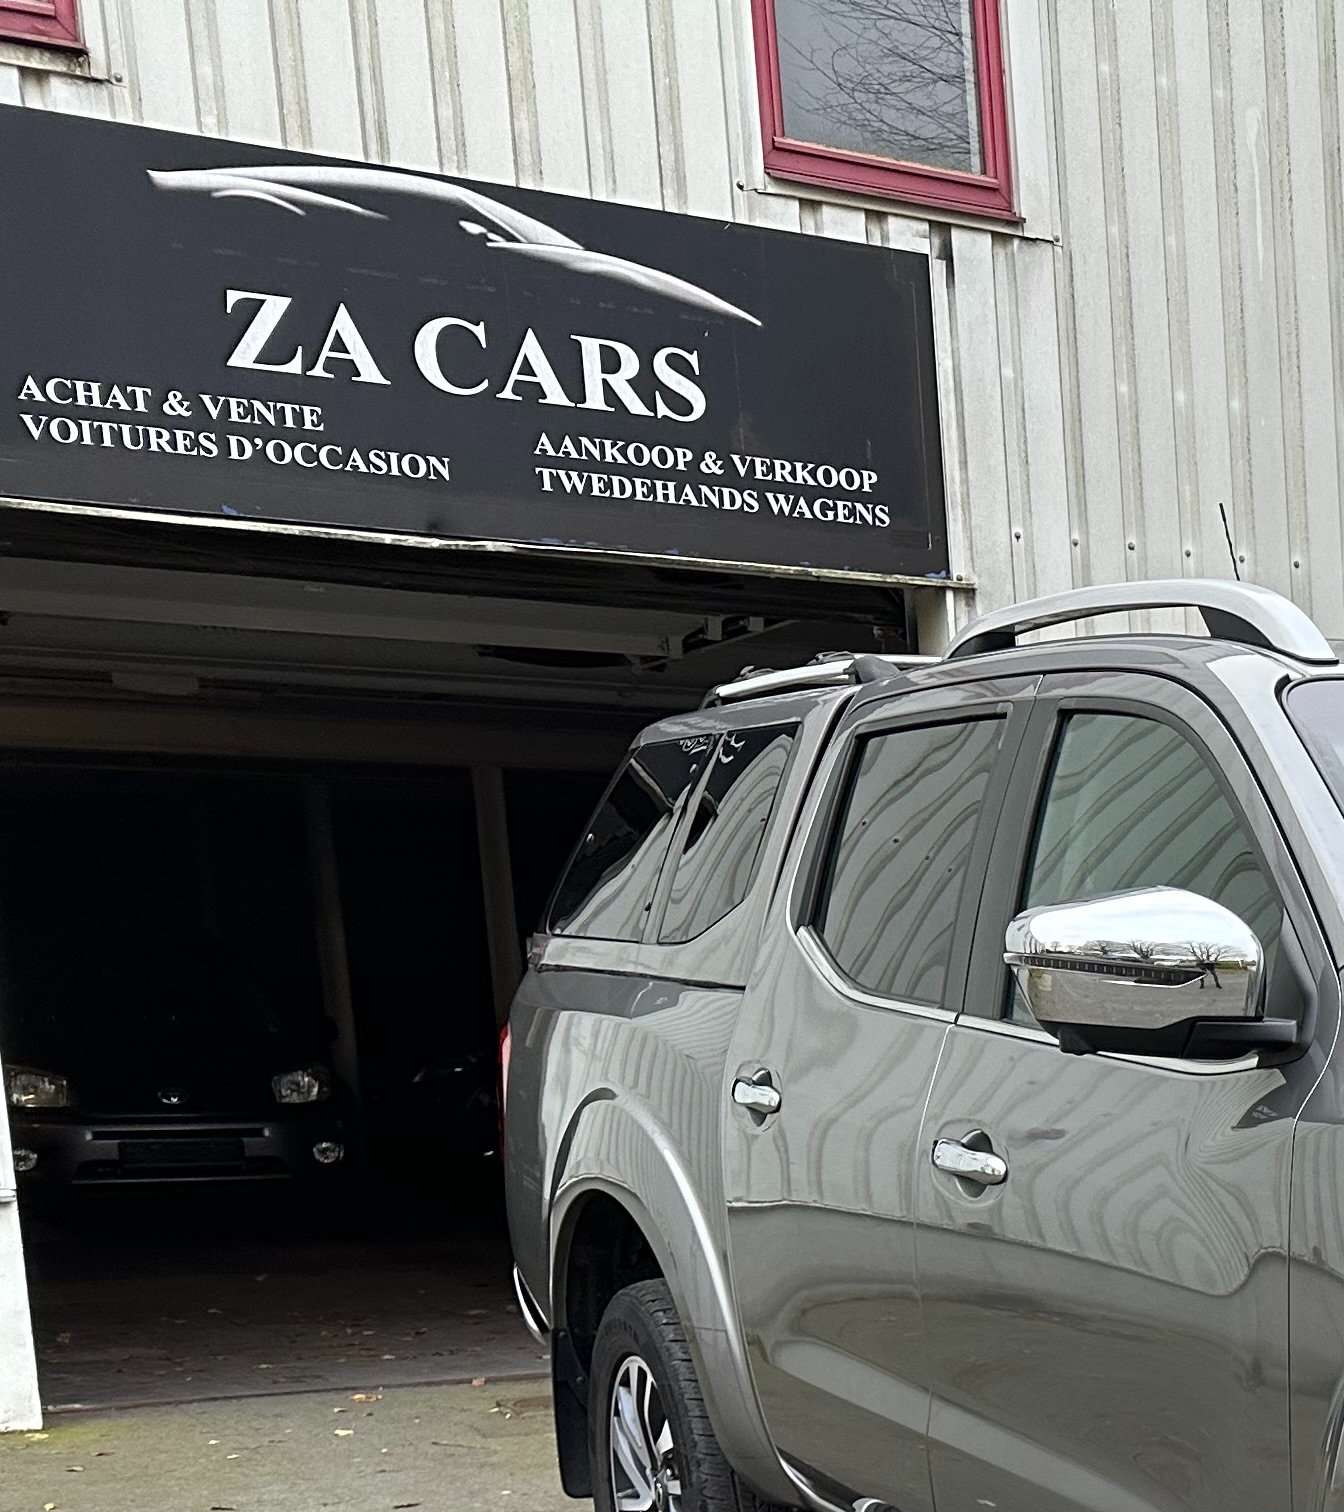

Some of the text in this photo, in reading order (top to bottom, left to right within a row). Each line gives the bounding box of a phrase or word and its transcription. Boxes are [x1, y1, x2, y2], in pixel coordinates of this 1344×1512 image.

[226, 289, 707, 423] ZA CARS
[17, 374, 325, 432] ACHAT & VENTE
[19, 413, 450, 482] VOITURES D'OCCASION
[533, 431, 878, 493] AANKOOP & VERKOOP
[534, 467, 891, 528] TWEDEHANDS WAGENS
